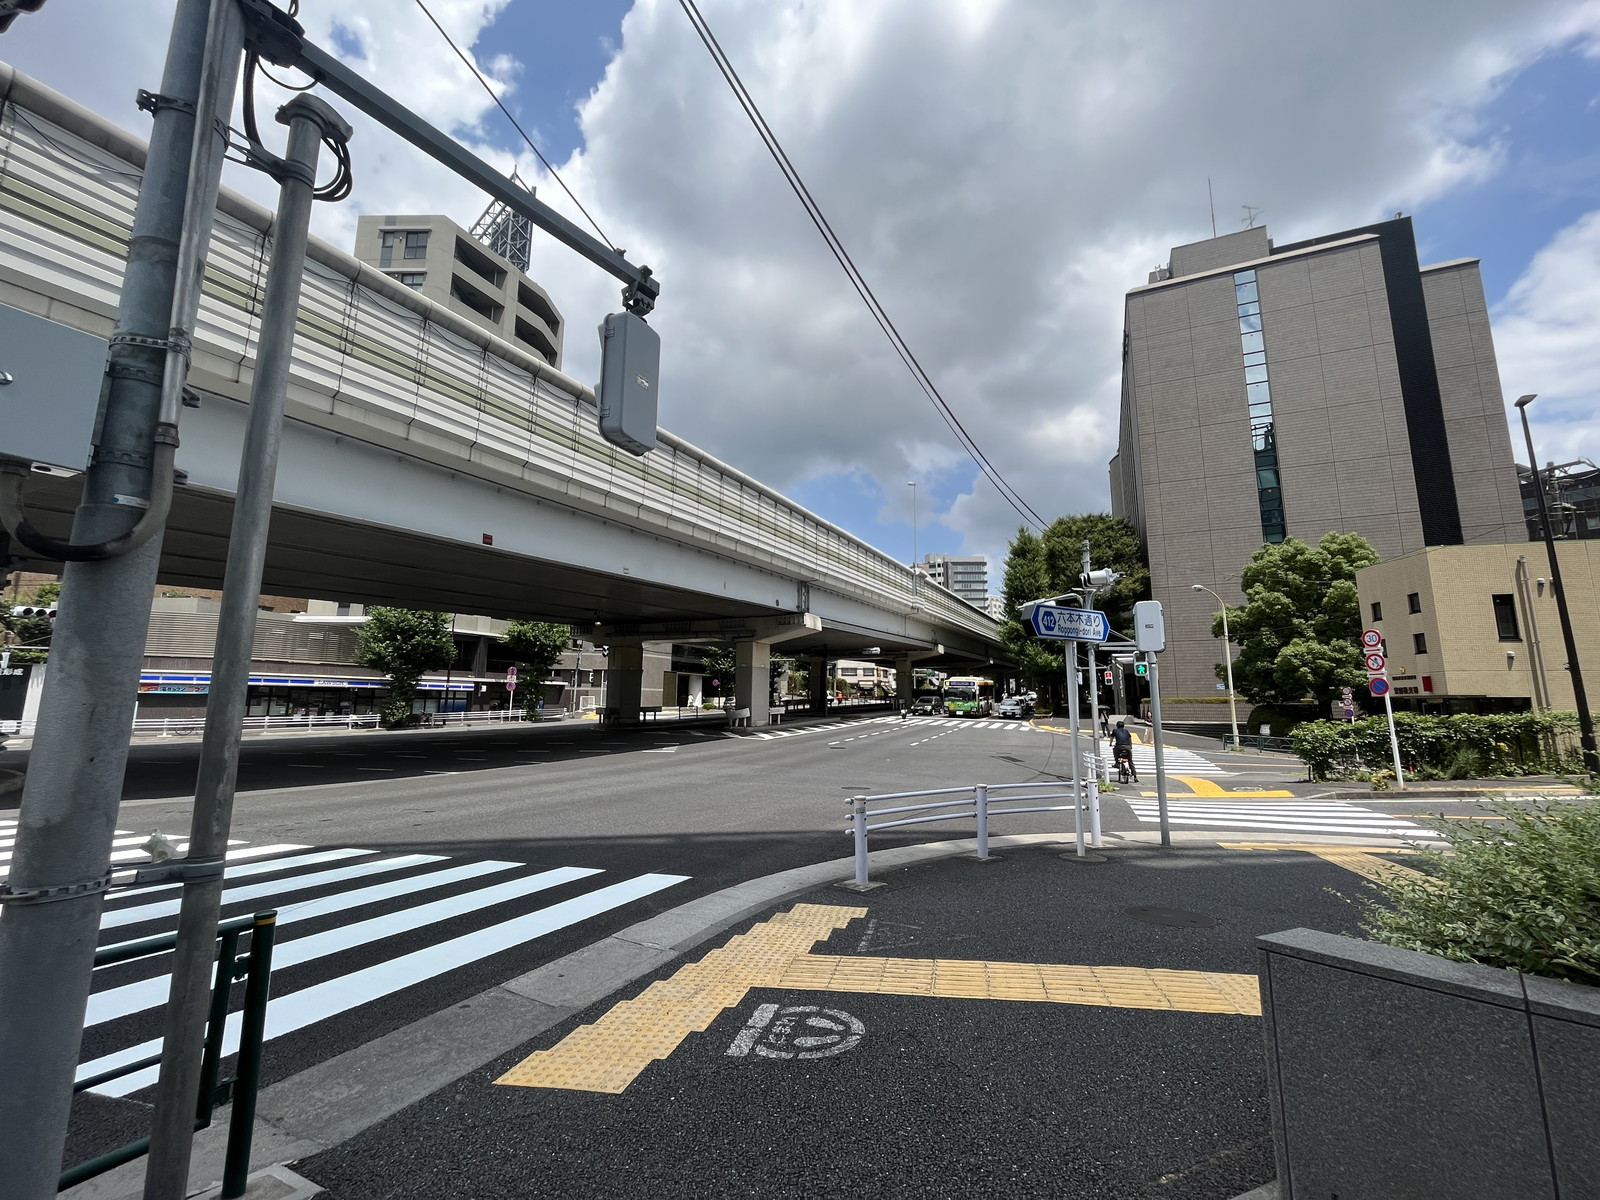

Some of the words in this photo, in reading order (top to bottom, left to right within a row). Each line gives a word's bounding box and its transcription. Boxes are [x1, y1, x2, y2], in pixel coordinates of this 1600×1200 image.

[1043, 616, 1055, 627] 412
[1057, 611, 1100, 627] 六本木通り
[1058, 624, 1092, 636] Roppongi-dori
[1366, 634, 1377, 643] 30
